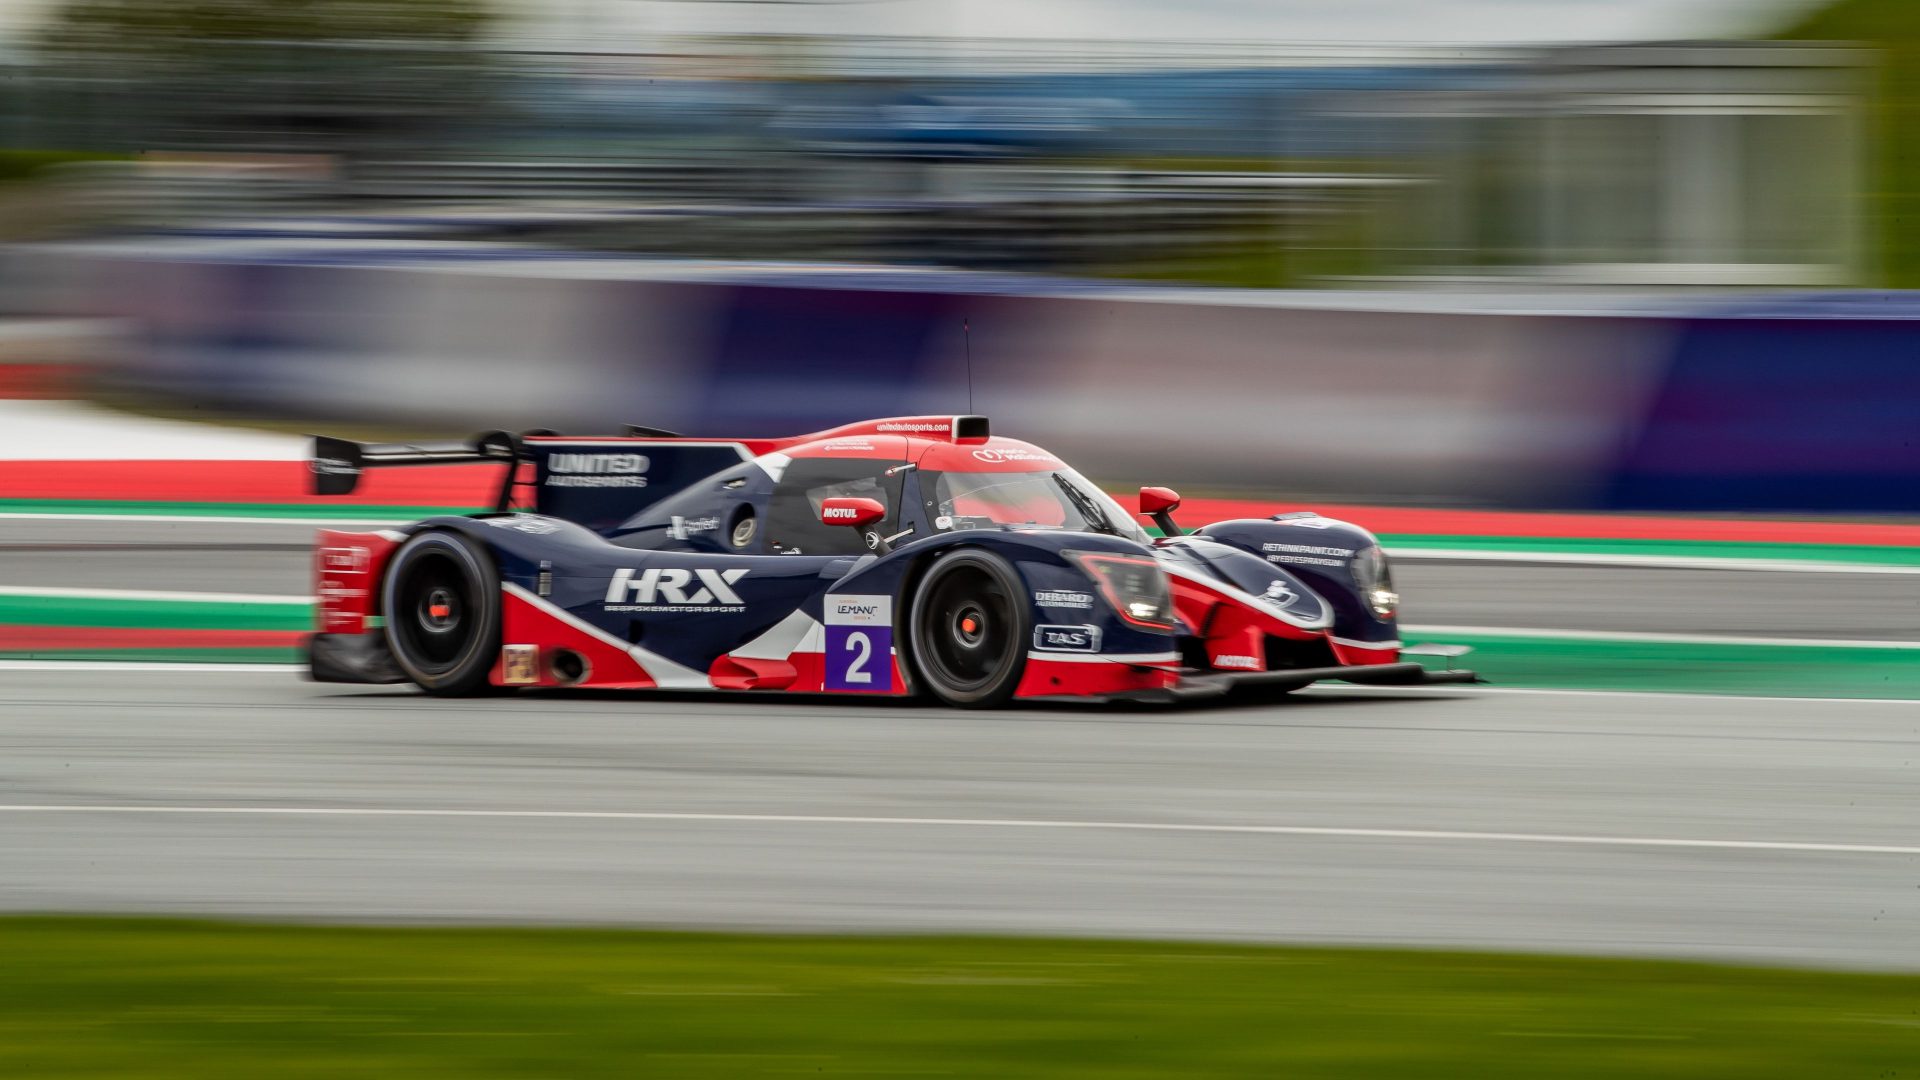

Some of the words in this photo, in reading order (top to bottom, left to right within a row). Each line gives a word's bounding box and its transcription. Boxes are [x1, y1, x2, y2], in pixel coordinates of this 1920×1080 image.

[876, 422, 949, 433] unitedautosports.com
[547, 453, 650, 474] UNITED
[823, 508, 858, 518] MOTUL
[604, 568, 751, 604] HRX
[1045, 632, 1087, 645] TAS
[845, 631, 872, 683] 2
